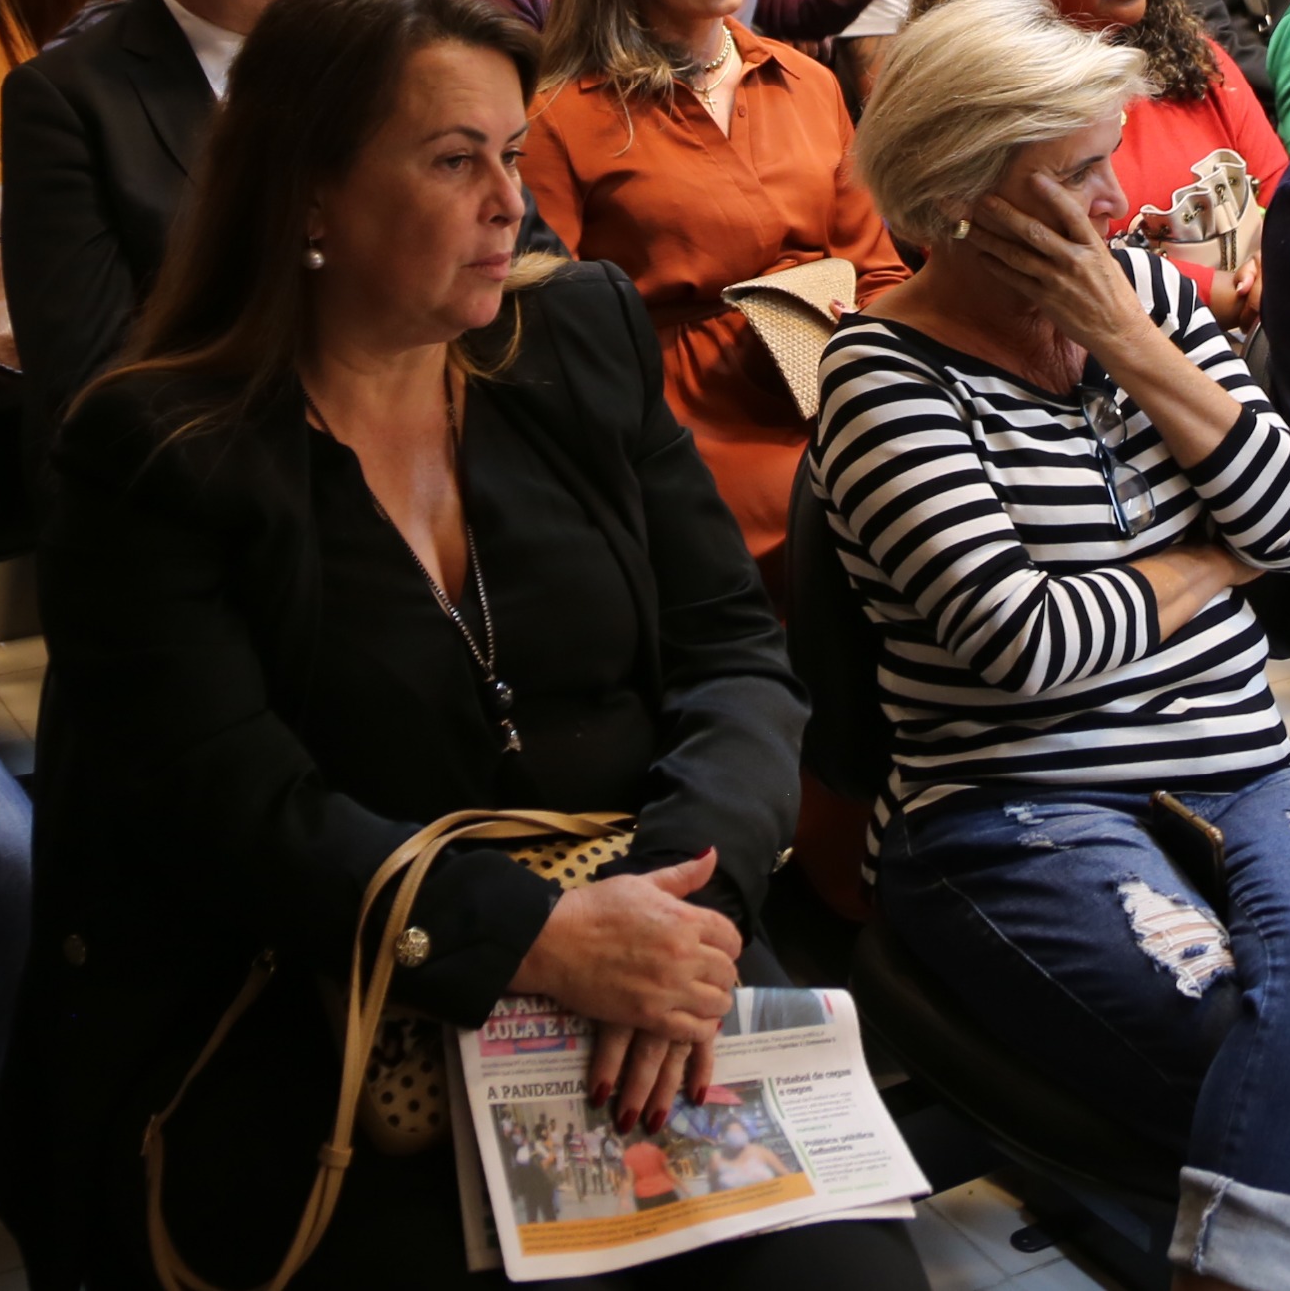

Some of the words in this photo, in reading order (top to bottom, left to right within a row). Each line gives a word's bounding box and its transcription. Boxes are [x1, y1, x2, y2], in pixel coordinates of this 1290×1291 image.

[484, 1018, 540, 1040] LULA
[545, 1017, 558, 1036] E
[487, 1084, 498, 1100] A
[501, 1079, 587, 1098] PANDEMIA
